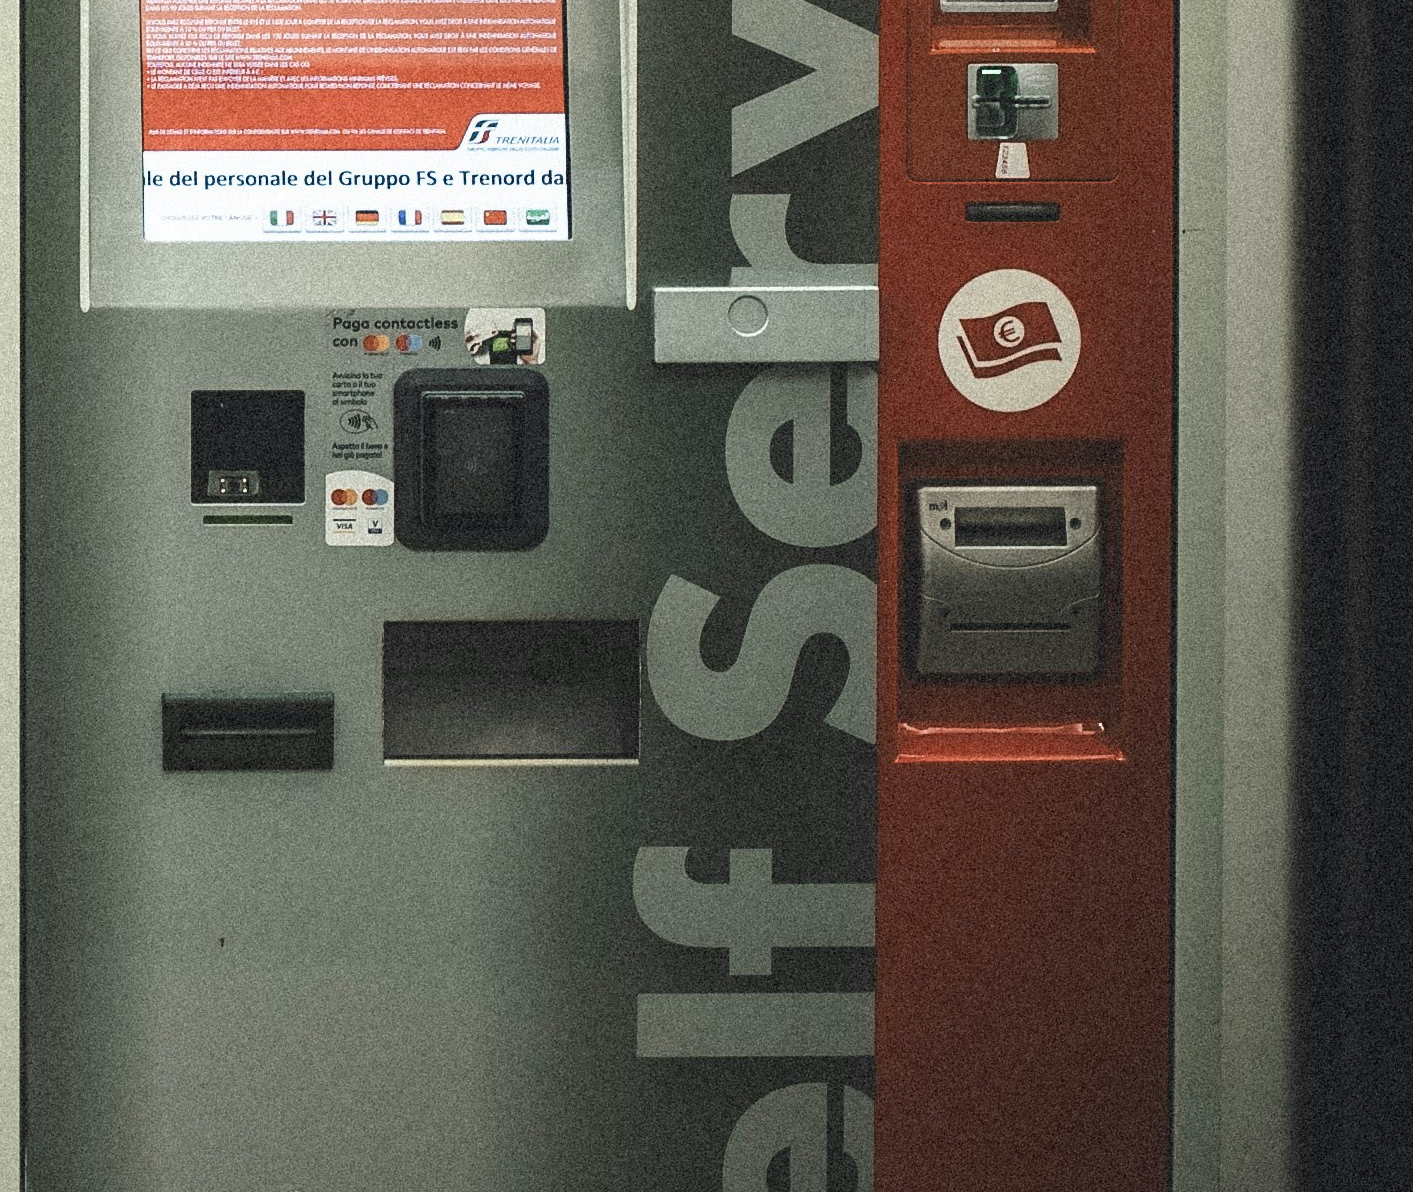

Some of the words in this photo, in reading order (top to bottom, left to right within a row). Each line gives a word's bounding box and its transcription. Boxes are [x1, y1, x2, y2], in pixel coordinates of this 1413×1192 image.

[496, 136, 560, 145] TRENITALIA
[169, 170, 198, 186] del
[204, 170, 298, 190] personale
[305, 170, 333, 186] del
[338, 170, 410, 190] Gruppo
[417, 171, 437, 186] FS
[444, 174, 454, 186] e
[459, 170, 537, 186] Trenord
[541, 170, 564, 186] da
[332, 317, 370, 333] Paga
[374, 316, 459, 331] contactless
[332, 337, 359, 348] con
